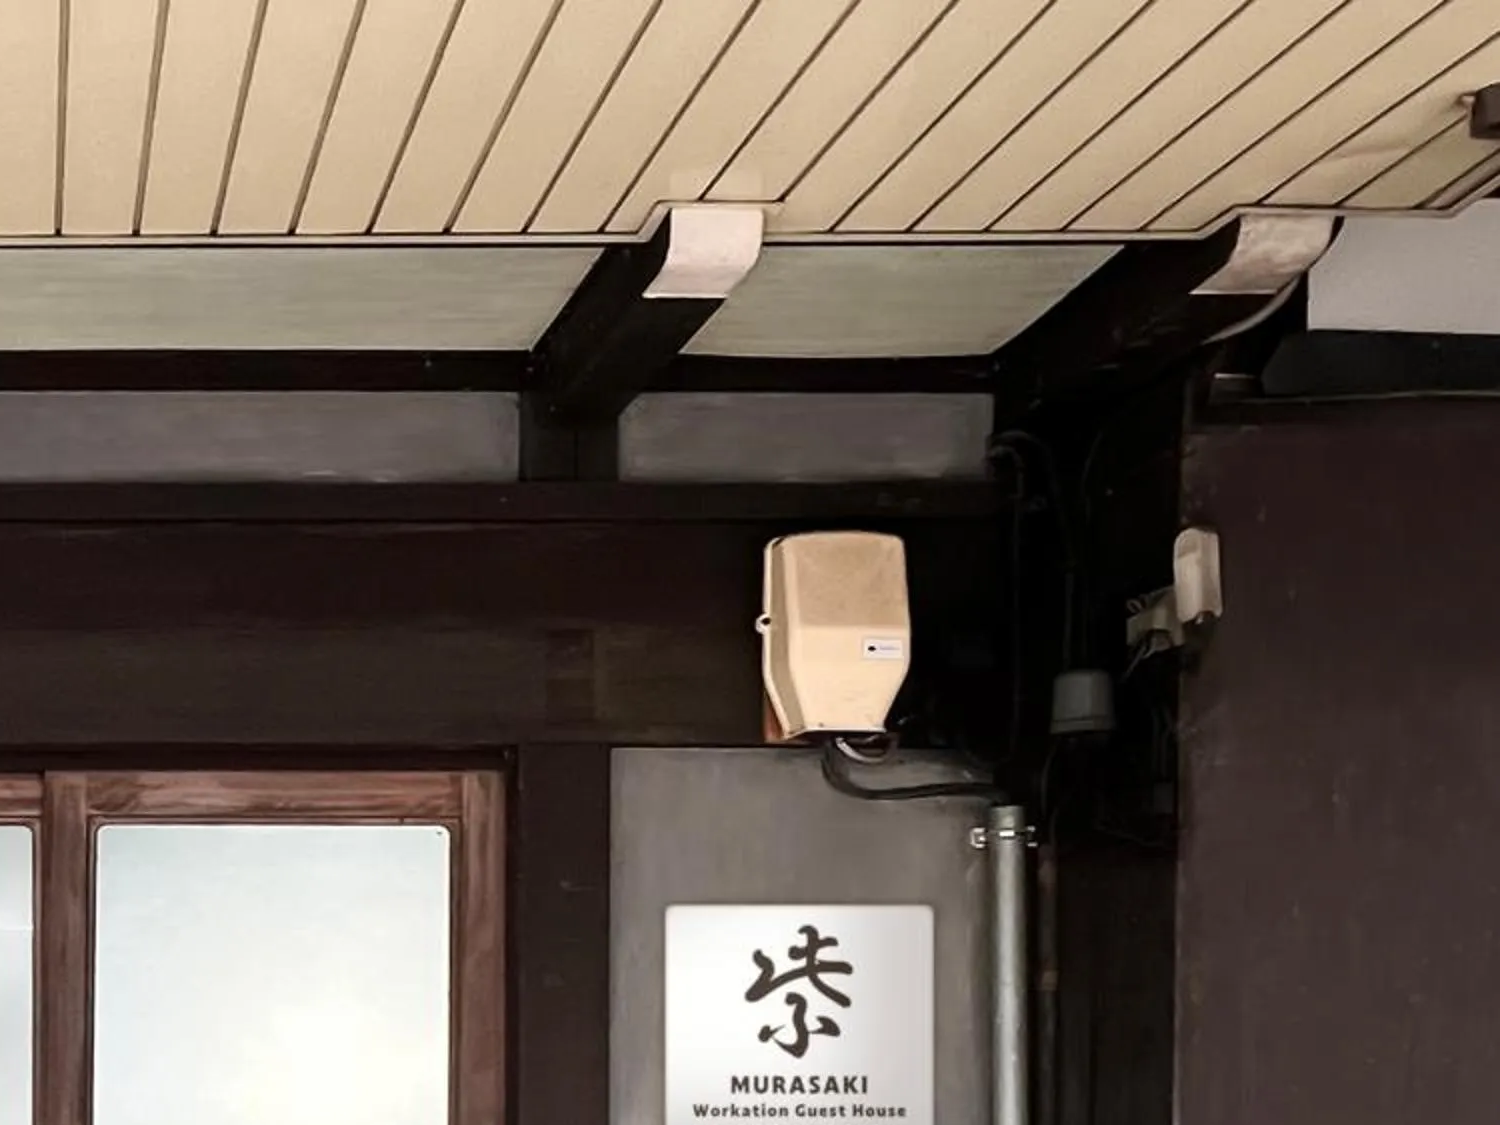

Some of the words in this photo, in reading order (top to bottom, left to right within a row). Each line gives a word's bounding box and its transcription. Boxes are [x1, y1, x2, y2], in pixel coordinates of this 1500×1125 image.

[730, 1075, 868, 1095] MURASAKI
[693, 1103, 789, 1118] Workation
[795, 1103, 846, 1118] Guest
[852, 1103, 907, 1118] House
